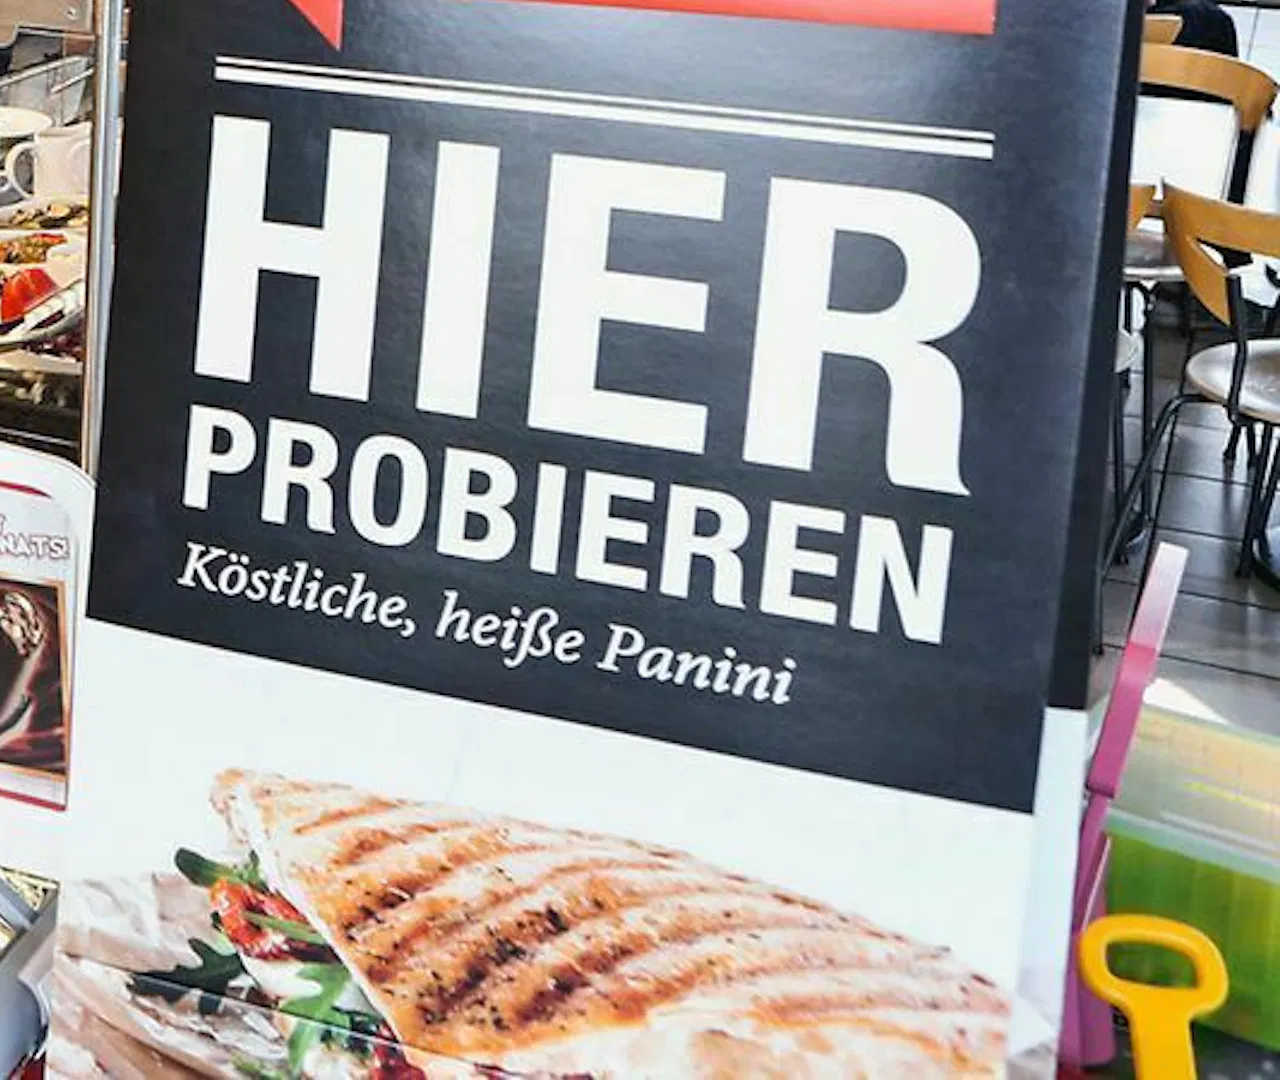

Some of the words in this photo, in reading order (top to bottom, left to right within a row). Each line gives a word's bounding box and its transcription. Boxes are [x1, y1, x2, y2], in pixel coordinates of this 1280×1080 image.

[195, 114, 982, 496] HIER
[177, 540, 417, 638] Köstliche,
[435, 590, 586, 668] heiße
[597, 621, 797, 705] Panini
[182, 404, 954, 645] PROBIEREN
